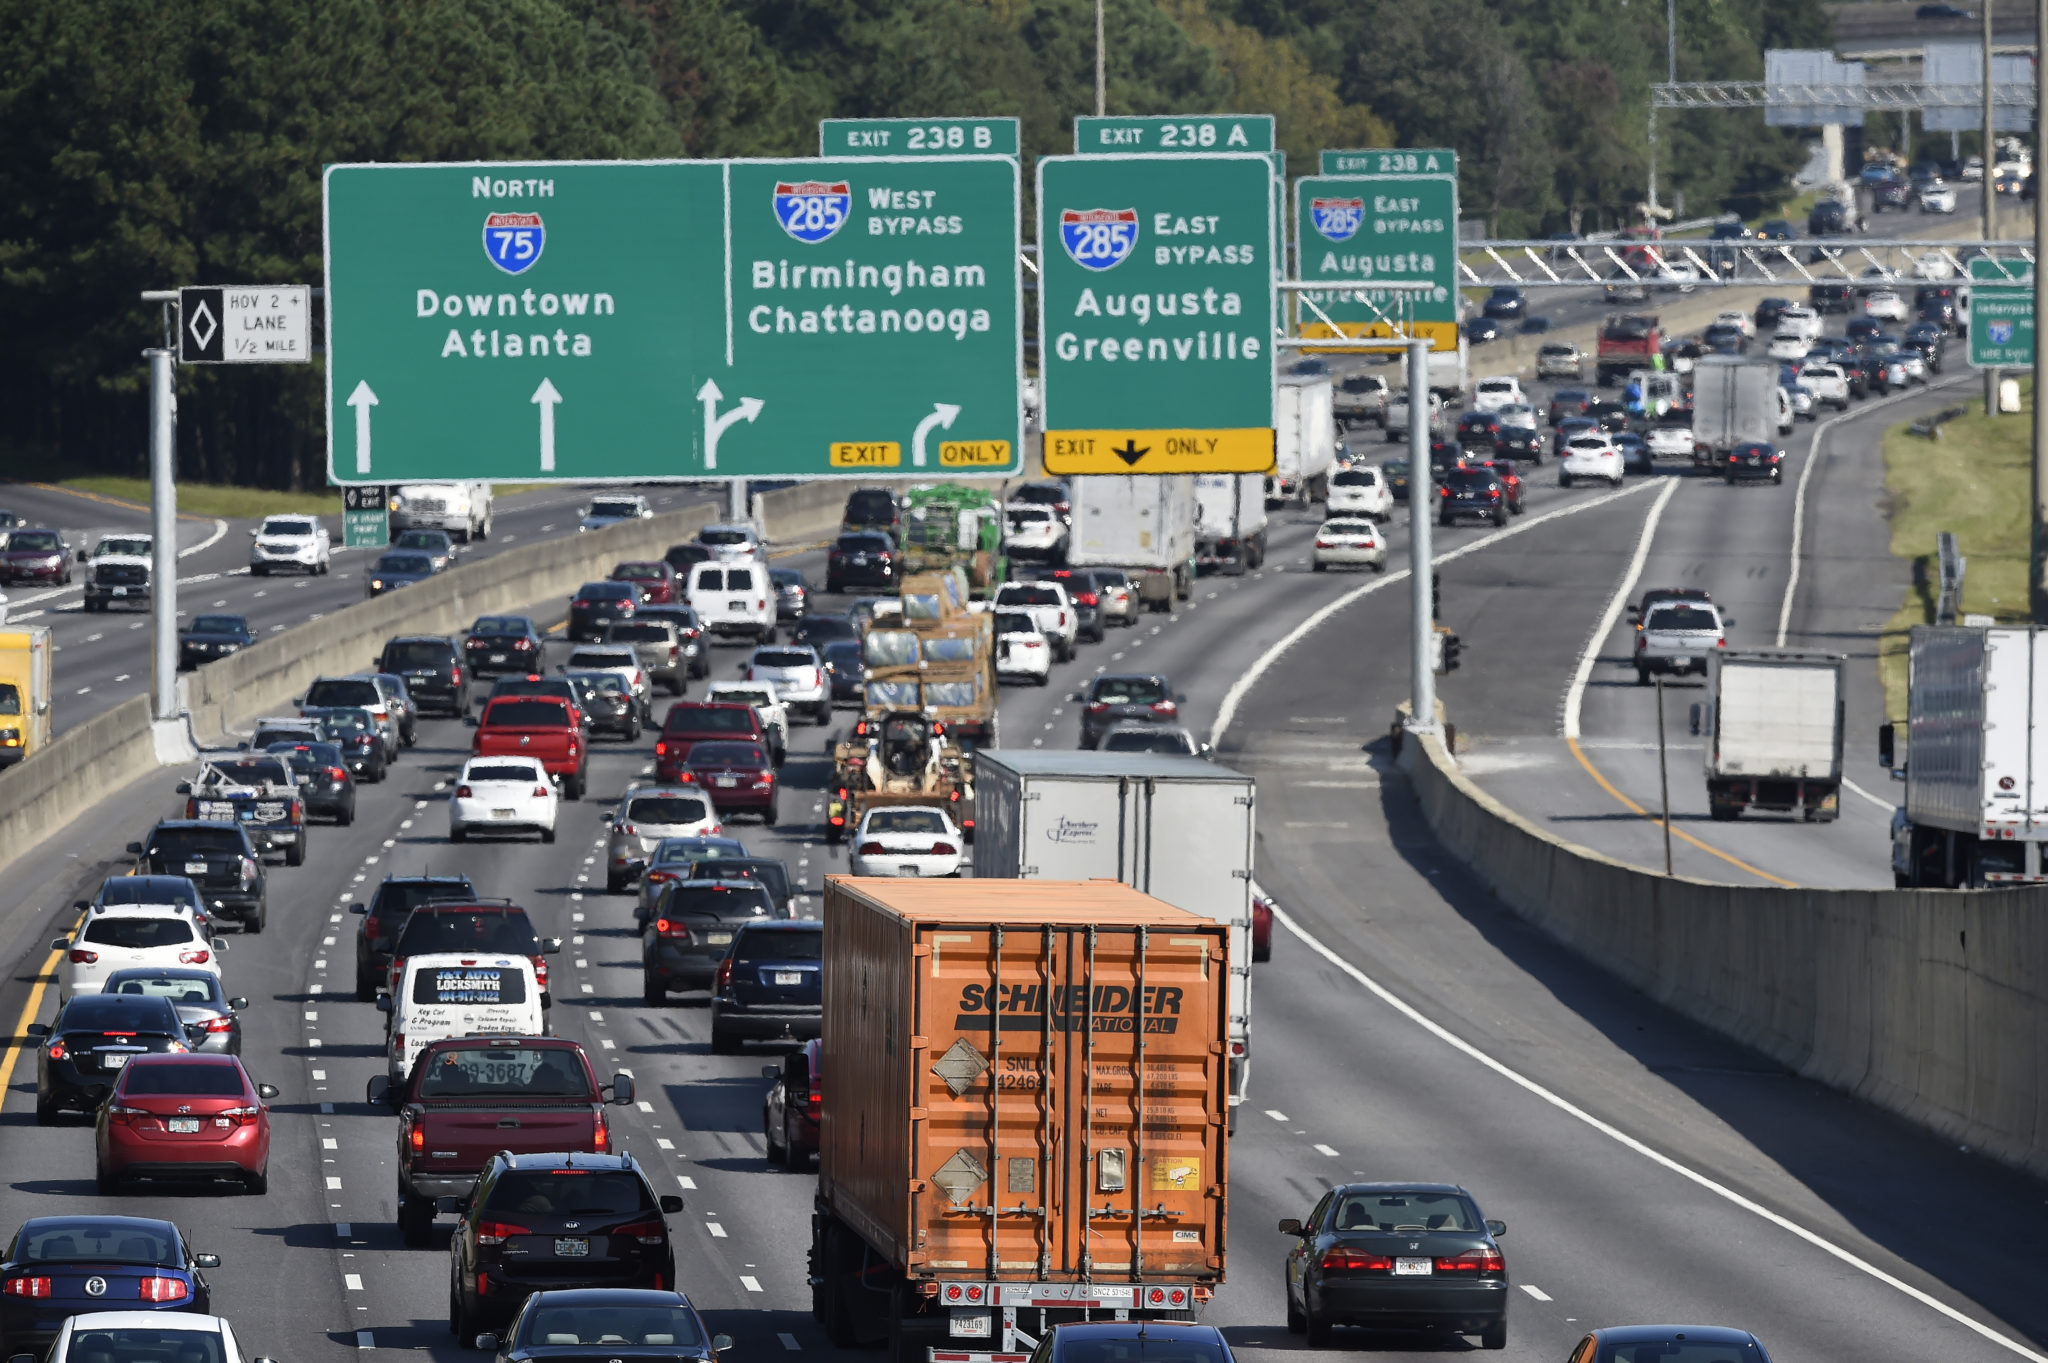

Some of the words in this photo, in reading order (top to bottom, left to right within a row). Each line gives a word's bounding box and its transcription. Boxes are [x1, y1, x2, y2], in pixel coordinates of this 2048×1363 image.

[847, 131, 892, 147] EXIT
[907, 126, 965, 149] 238
[973, 126, 993, 149] B
[1100, 128, 1144, 144] EXIT
[1160, 124, 1217, 147] 238
[1227, 124, 1249, 147] A
[1336, 156, 1367, 171] EXIT
[1379, 154, 1418, 172] 238
[1425, 154, 1440, 172] A
[786, 197, 842, 232] 285
[868, 215, 963, 236] BYPASS
[1373, 218, 1444, 234] BYPASS
[493, 231, 535, 260] 75
[1073, 225, 1131, 260] 285
[1155, 245, 1255, 266] BYPASS
[1319, 251, 1435, 278] Augusta
[752, 259, 986, 297] Birmingham
[231, 294, 259, 309] HOV
[416, 288, 616, 318] Downtown
[1074, 287, 1242, 326] Augusta
[243, 314, 287, 331] LANE
[748, 303, 991, 341] Chattanooga
[266, 339, 296, 352] MILE
[441, 328, 592, 358] Atlanta
[1055, 331, 1261, 362] Greenville
[839, 446, 888, 463] EXIT
[943, 444, 1004, 463] ONLY
[1055, 439, 1096, 456] EXIT
[1165, 438, 1218, 457] ONLY
[436, 970, 463, 980] J&T
[465, 970, 500, 980] AUTO
[436, 979, 500, 991] LOCKSMITH
[959, 983, 1184, 1015] SCHNEIDER
[417, 1008, 432, 1017] Key
[433, 1008, 446, 1016] Cut
[418, 1017, 451, 1027] Program
[476, 1024, 499, 1032] Broken
[1095, 1107, 1108, 1118] NET
[1175, 1231, 1197, 1239] CIMC
